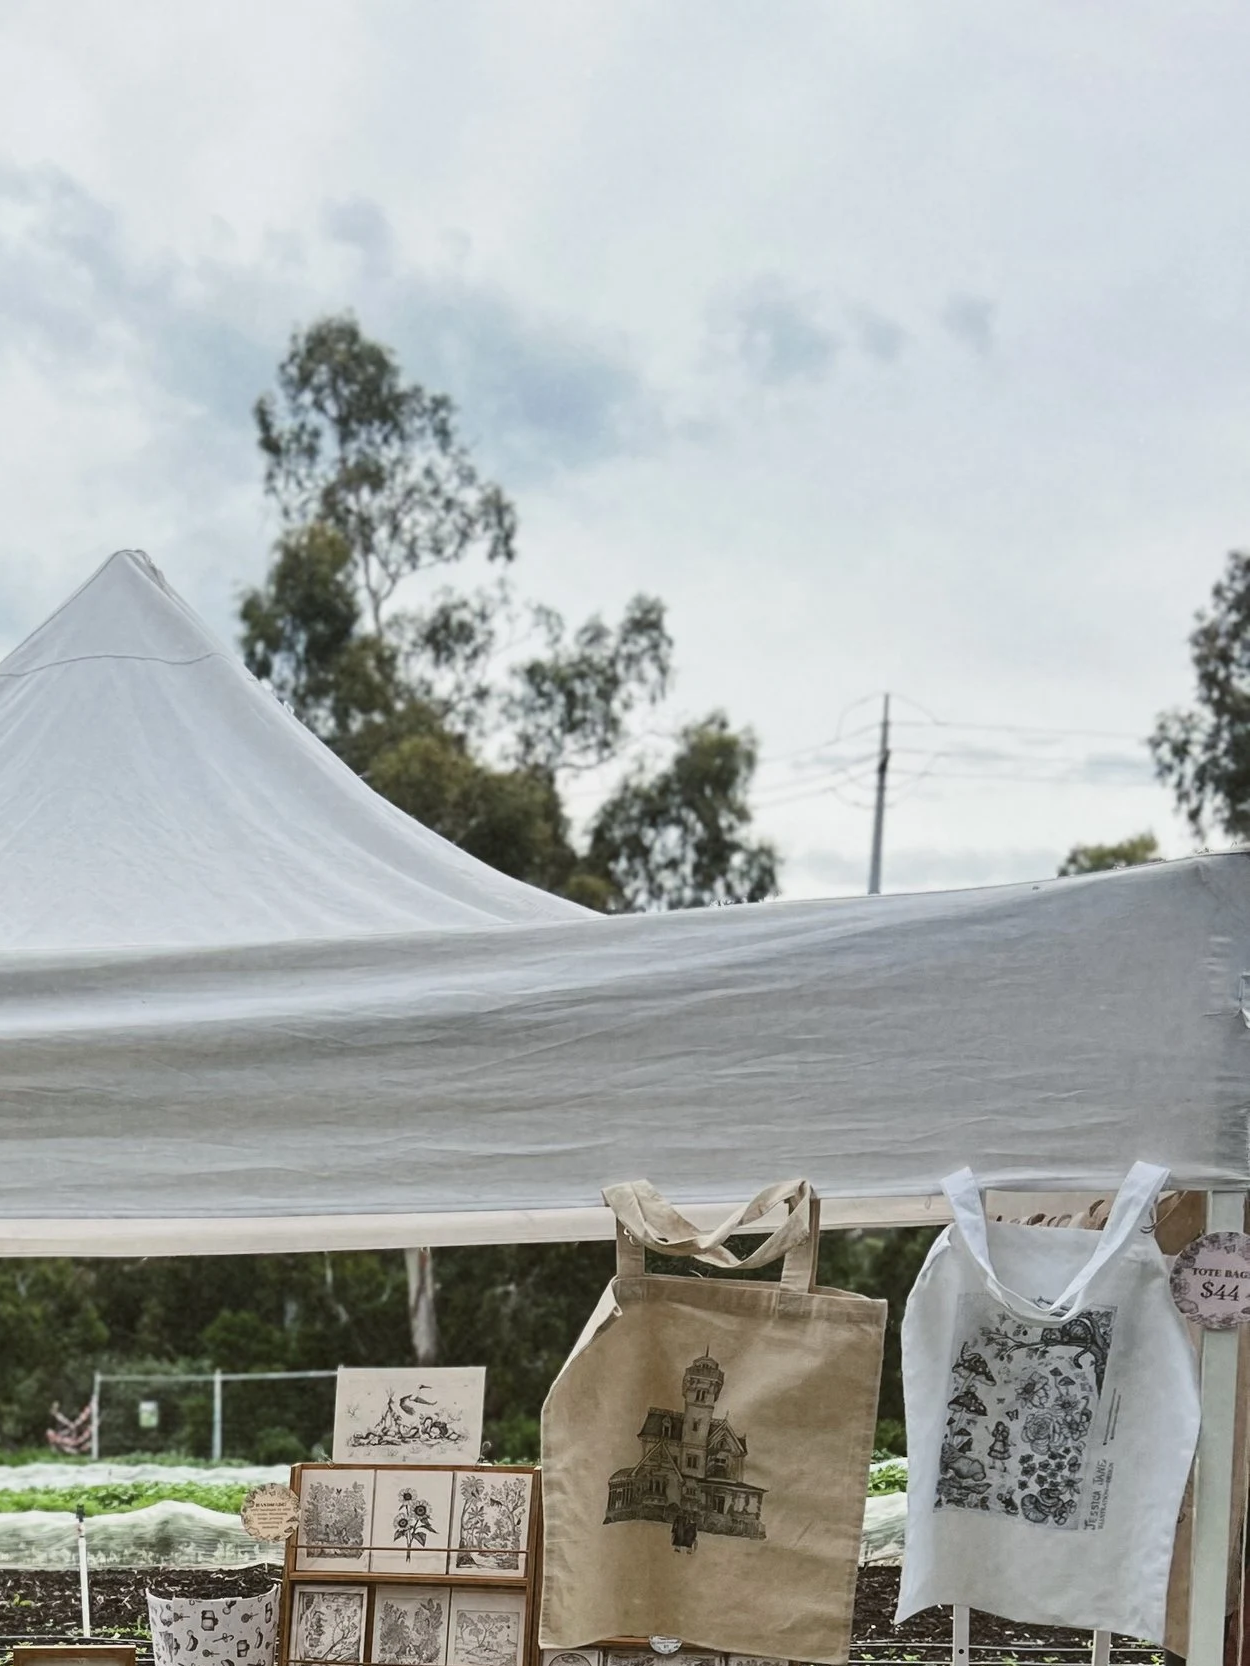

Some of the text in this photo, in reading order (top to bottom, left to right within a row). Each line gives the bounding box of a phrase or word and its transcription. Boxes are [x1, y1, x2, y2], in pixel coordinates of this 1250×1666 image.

[1192, 1268, 1221, 1277] TOTE
[1200, 1280, 1239, 1301] $44
[1083, 1458, 1107, 1531] JESSICA JANE
